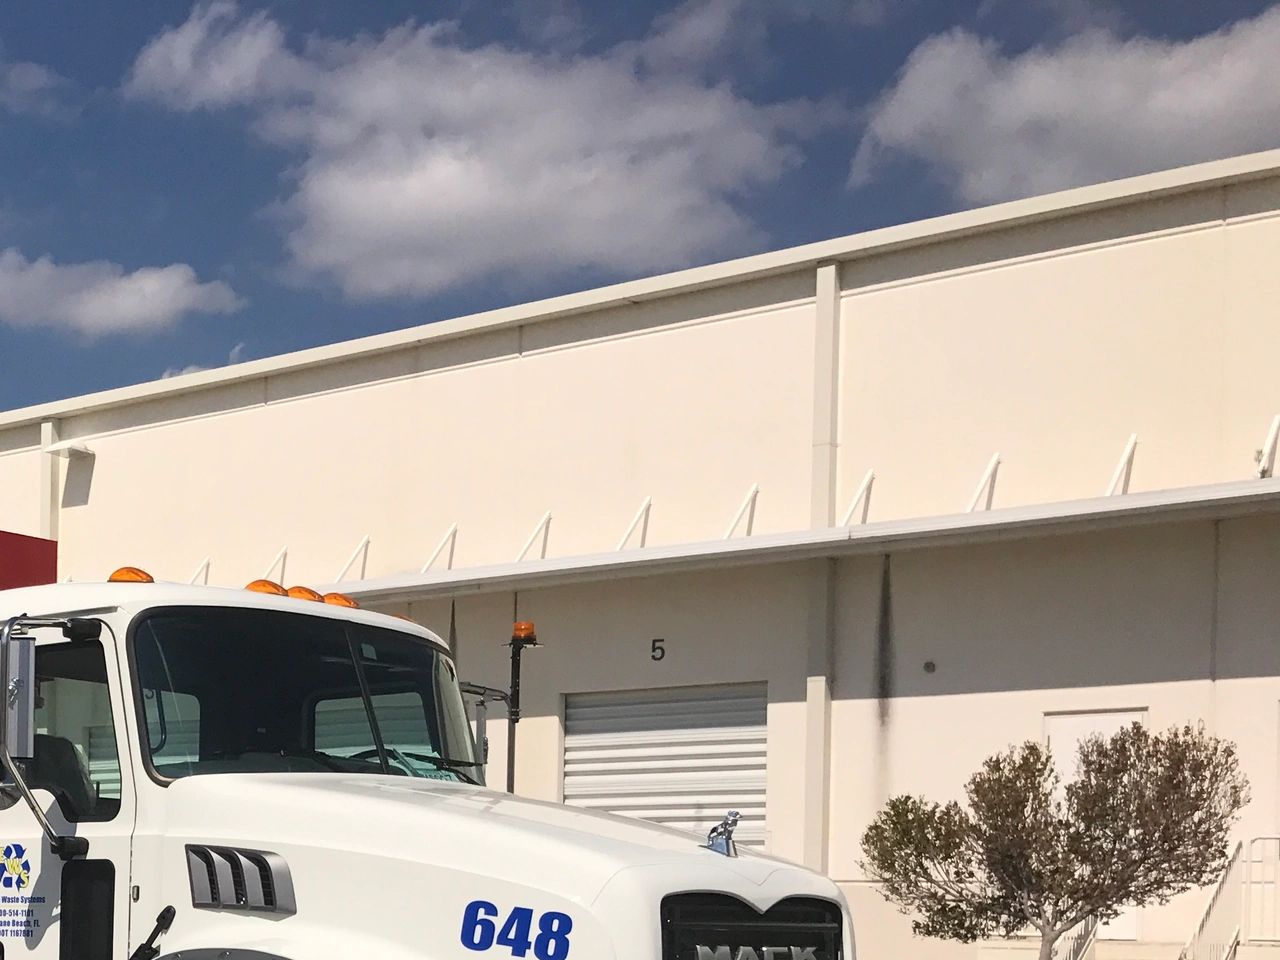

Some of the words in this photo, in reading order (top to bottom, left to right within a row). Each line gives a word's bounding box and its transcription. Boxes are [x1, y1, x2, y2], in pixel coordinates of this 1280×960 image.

[651, 638, 665, 661] 5
[1, 895, 20, 904] Waste
[20, 895, 46, 904] Systems
